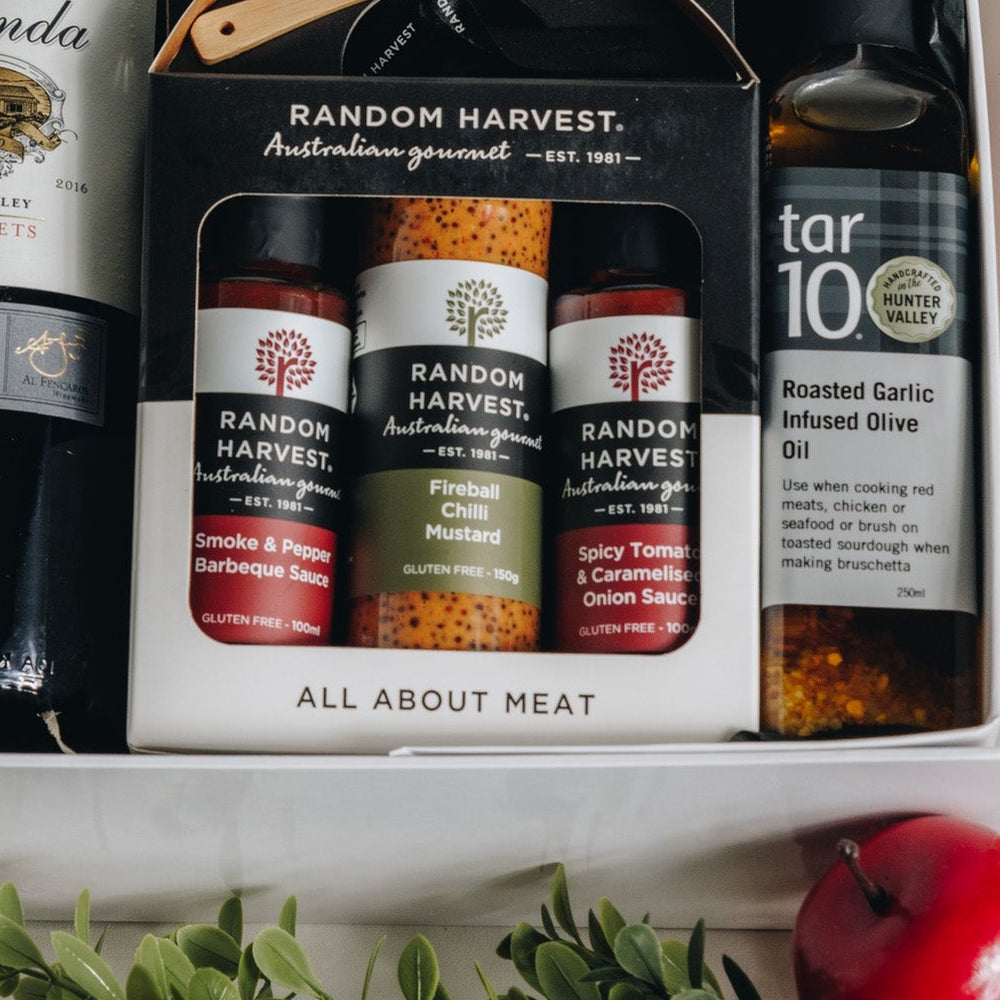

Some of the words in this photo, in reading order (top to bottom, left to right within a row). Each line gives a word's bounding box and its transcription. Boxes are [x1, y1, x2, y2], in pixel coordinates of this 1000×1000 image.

[290, 104, 442, 129] RANDOM
[264, 133, 403, 158] Australian
[407, 141, 511, 170] gourmet
[546, 151, 580, 164] EST.
[587, 152, 621, 164] 1981
[56, 178, 88, 194] 2016
[779, 204, 864, 254] tar
[883, 269, 941, 292] HANDCRAFTED
[883, 293, 940, 308] HUNTER
[886, 309, 938, 325] VALLEY
[783, 379, 865, 399] Roasted
[873, 382, 934, 404] Garlic
[783, 411, 859, 430] Infused
[868, 412, 919, 432] Olive
[783, 440, 808, 459] Oil
[429, 480, 500, 499] Fireball
[782, 479, 808, 491] Use
[813, 480, 849, 492] when
[854, 481, 907, 496] cooking
[913, 483, 934, 496] red
[441, 502, 488, 521] Chilli
[782, 498, 827, 513] meats,
[833, 498, 887, 513] chicken
[893, 502, 905, 513] or
[426, 524, 501, 545] Mustard
[782, 518, 834, 531] seafood
[840, 520, 852, 531] or
[859, 519, 896, 532] brush
[902, 524, 918, 534] on
[195, 533, 258, 550] Smoke
[264, 537, 277, 552] &
[283, 539, 331, 564] Pepper
[781, 537, 831, 550] toasted
[837, 538, 908, 554] sourdough
[914, 542, 949, 554] when
[195, 558, 284, 579] Barbeque
[289, 565, 329, 588] Sauce
[782, 556, 832, 571] making
[837, 557, 910, 572] bruschetta
[493, 570, 519, 585] 150g
[292, 620, 321, 636] 100ml
[297, 687, 357, 709] ALL
[374, 689, 488, 711] ABOUT
[506, 692, 596, 716] MEAT
